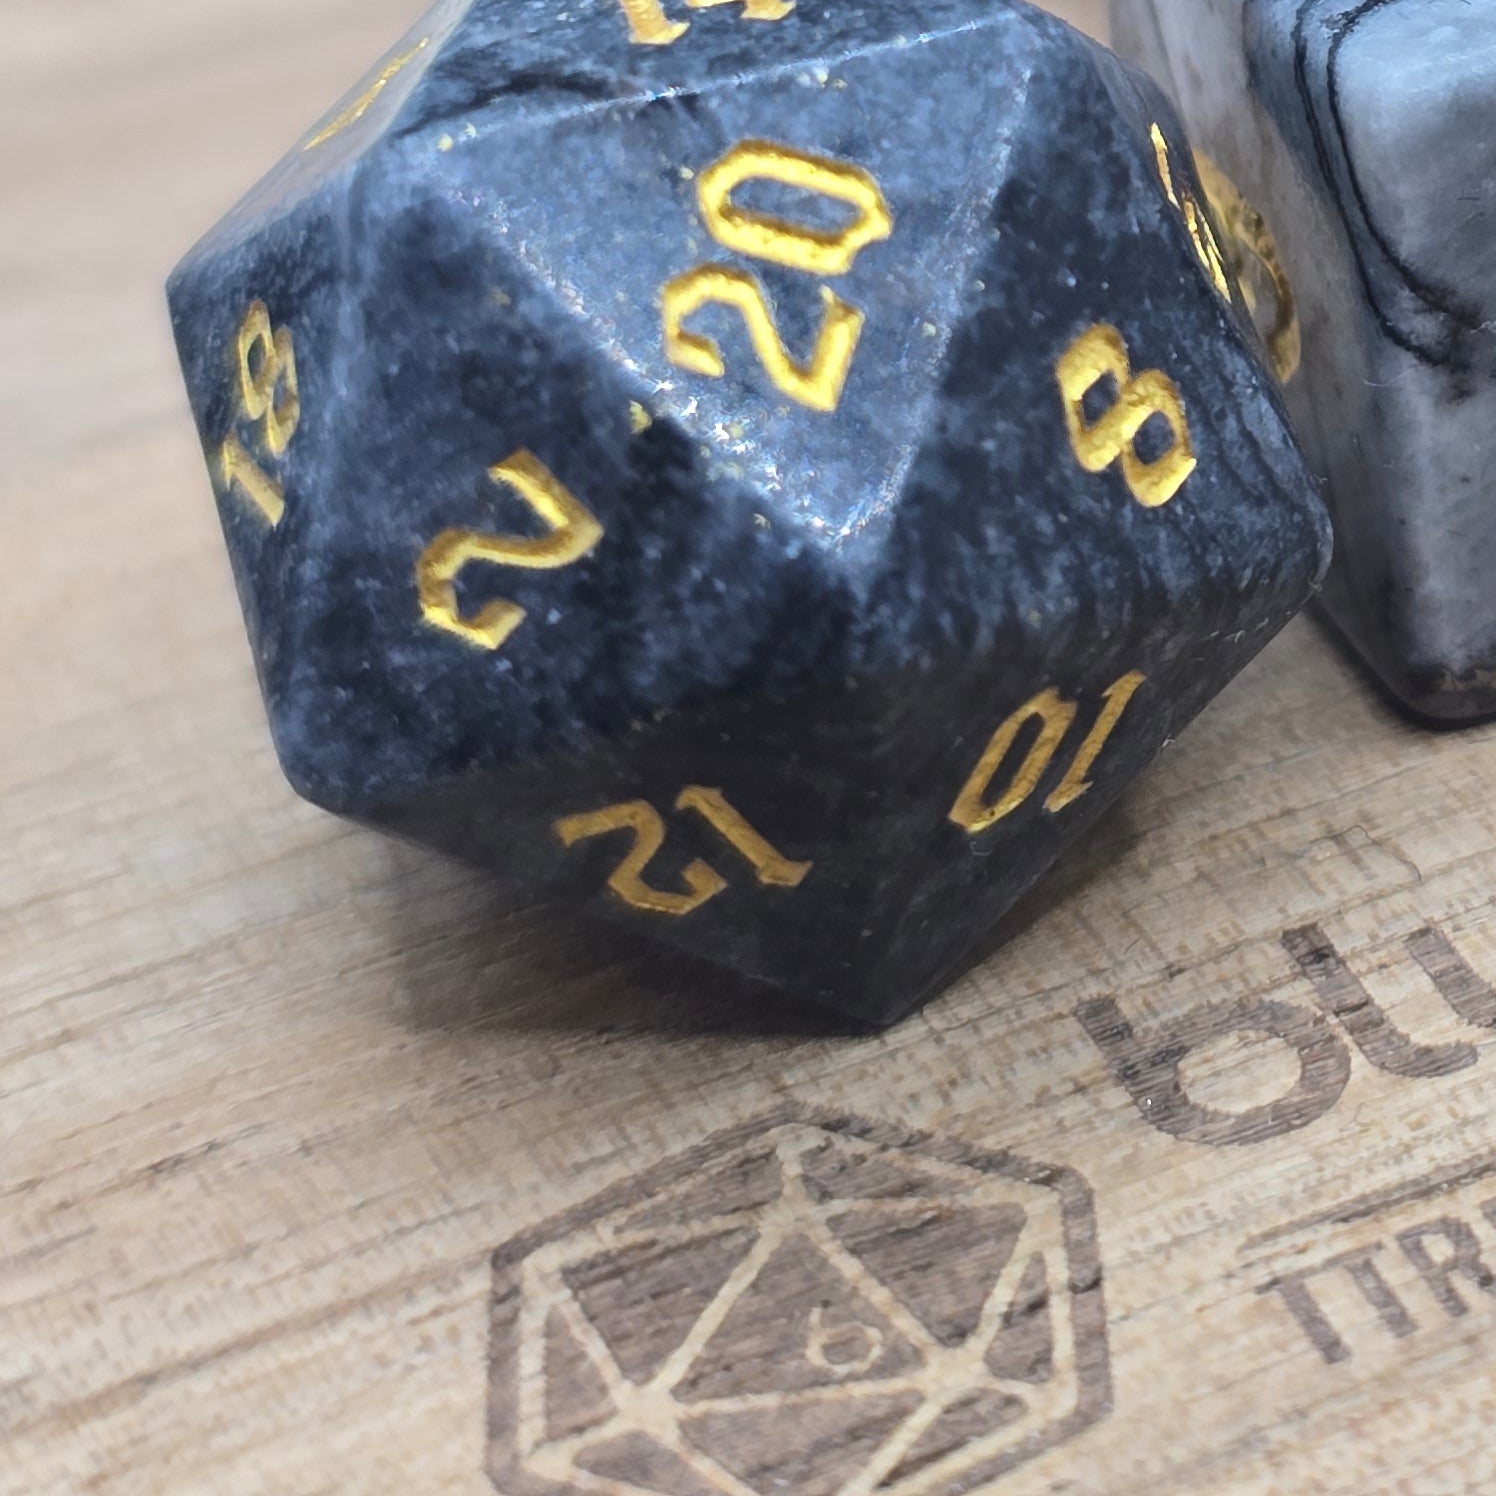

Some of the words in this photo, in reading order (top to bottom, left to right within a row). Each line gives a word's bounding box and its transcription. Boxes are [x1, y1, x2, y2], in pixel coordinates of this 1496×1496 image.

[660, 137, 894, 413] 20
[1055, 323, 1198, 508] 8
[415, 448, 604, 651] 2
[948, 670, 1149, 835] 10
